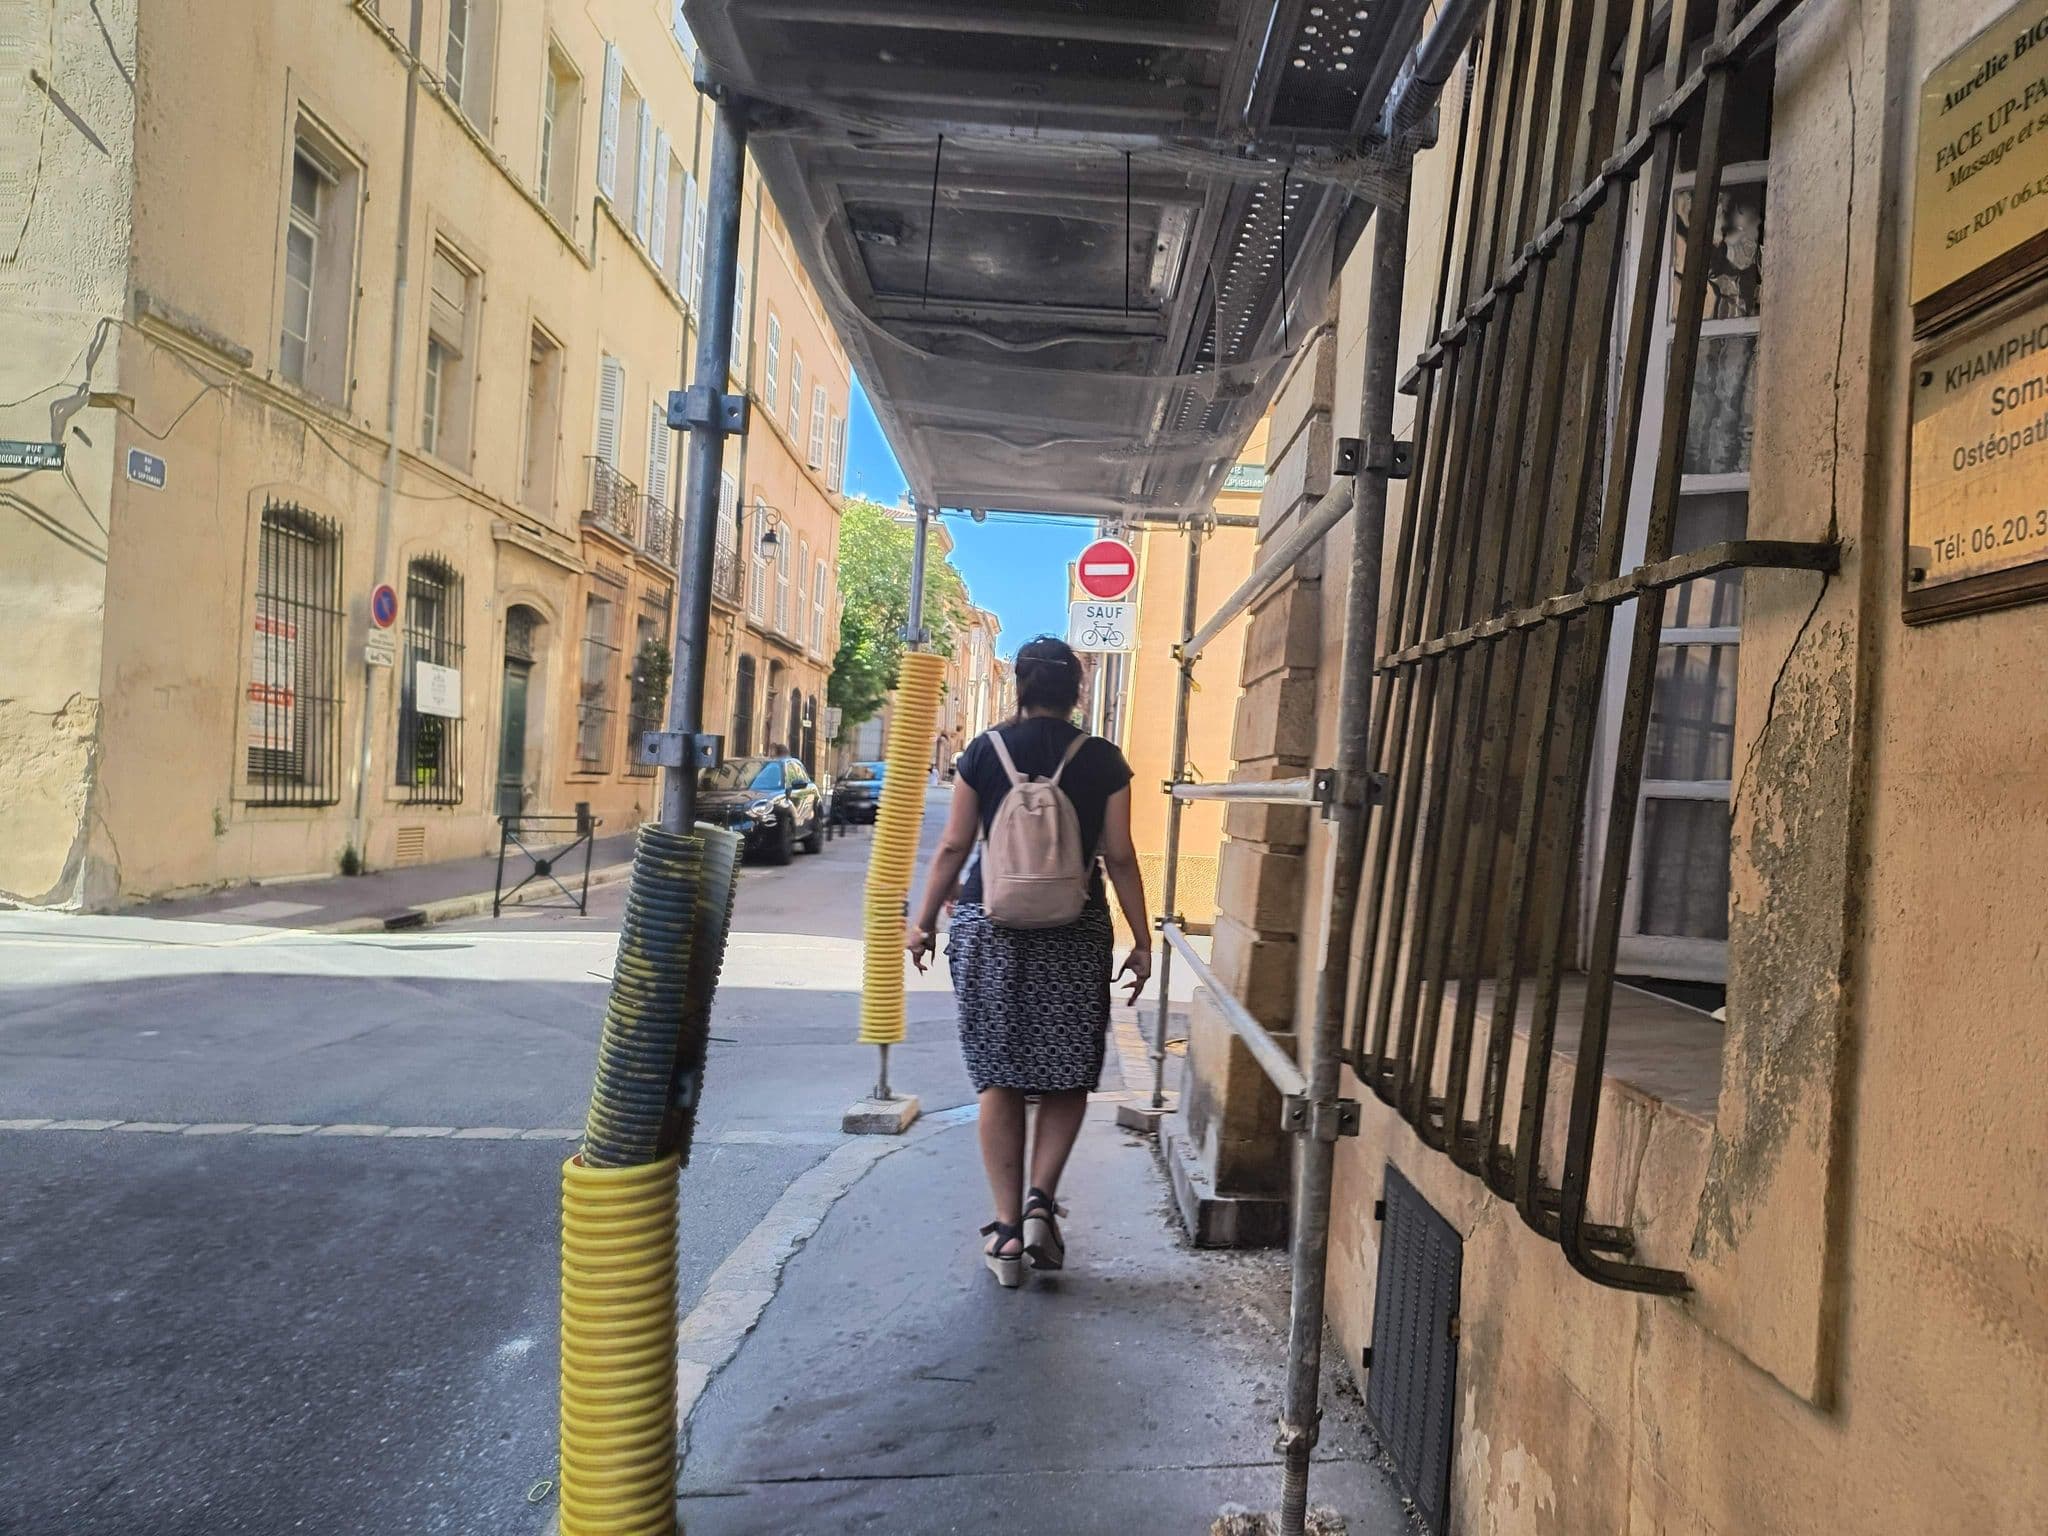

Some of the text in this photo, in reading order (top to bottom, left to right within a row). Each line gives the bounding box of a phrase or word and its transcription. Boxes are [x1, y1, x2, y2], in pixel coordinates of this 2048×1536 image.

[1938, 54, 2009, 117] Aurélie
[1936, 121, 1983, 172] FACE
[1946, 136, 2015, 193] Massage
[2018, 121, 2034, 144] et
[1945, 224, 1971, 250] Sur
[1973, 196, 2009, 233] RDV
[1991, 374, 2048, 416] Som
[1934, 509, 2048, 564] Tél: 06.20.3
[1086, 606, 1123, 619] SAUF
